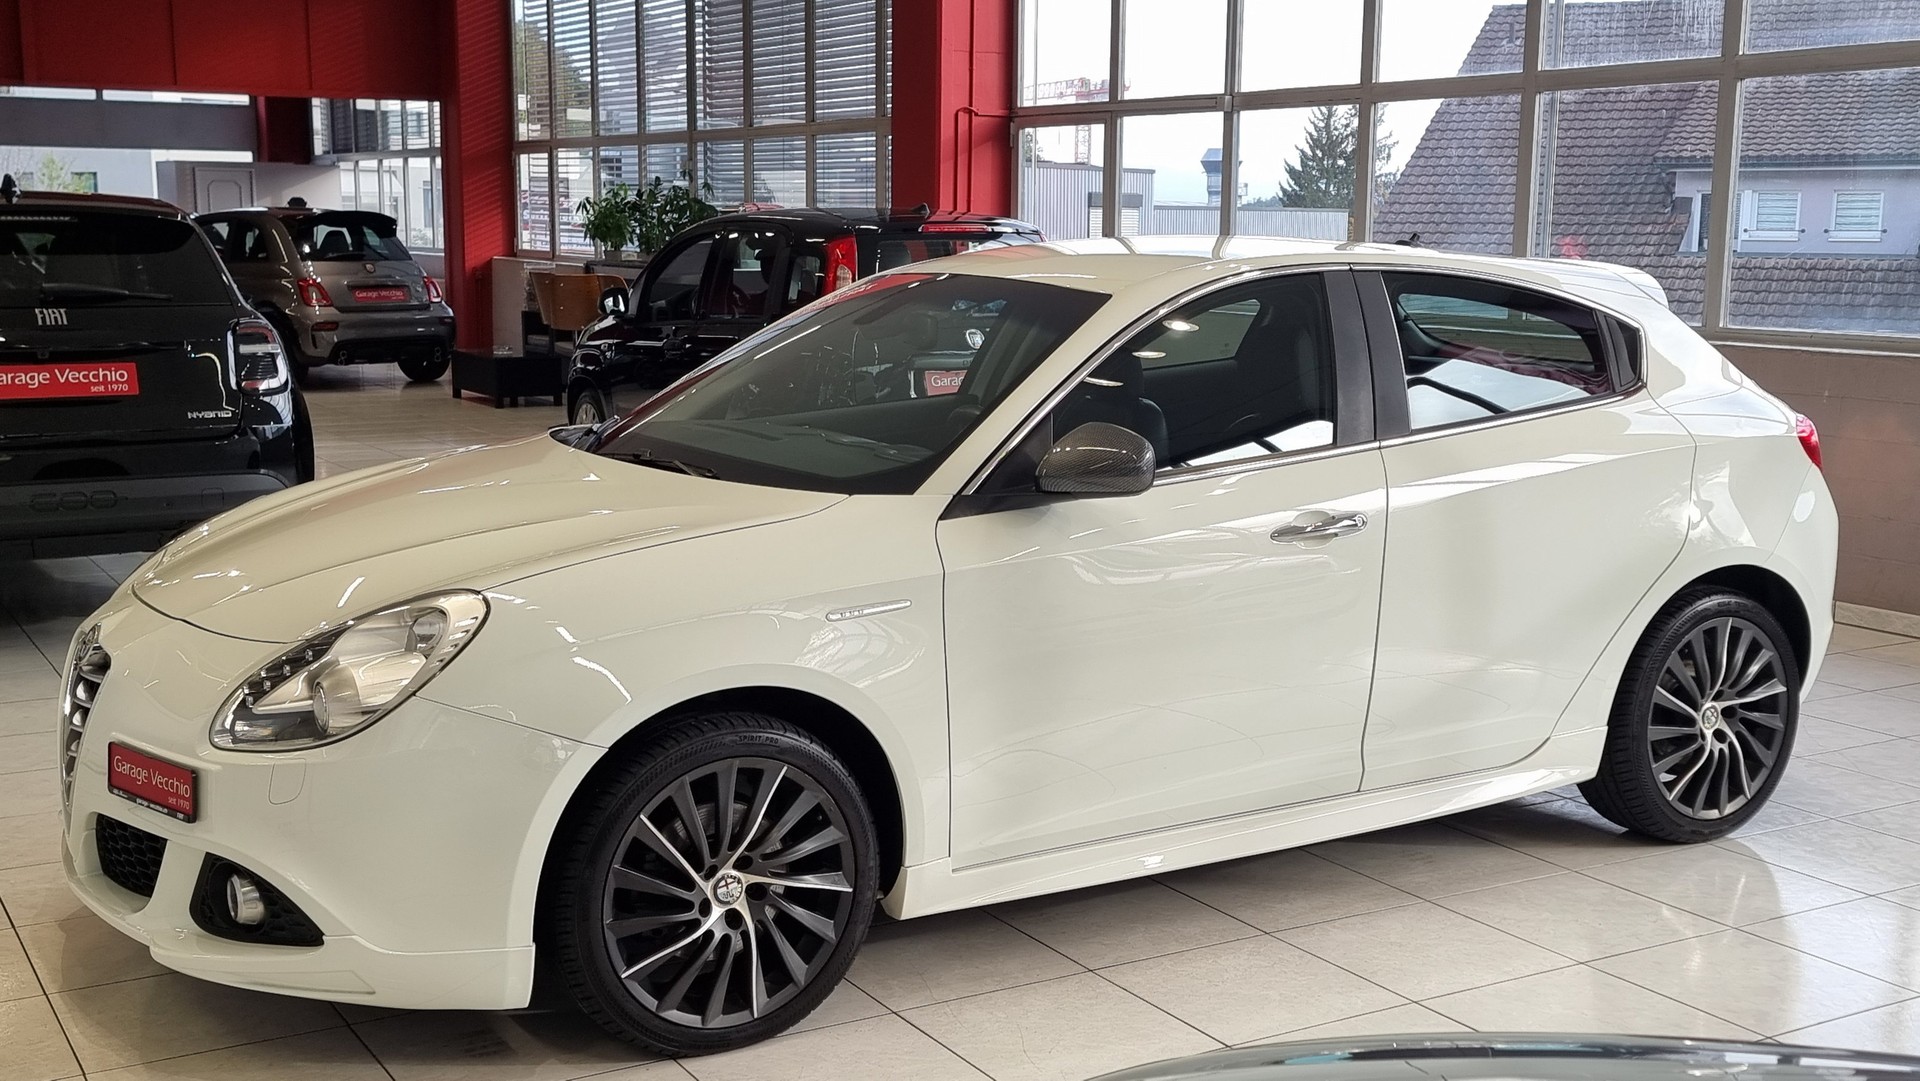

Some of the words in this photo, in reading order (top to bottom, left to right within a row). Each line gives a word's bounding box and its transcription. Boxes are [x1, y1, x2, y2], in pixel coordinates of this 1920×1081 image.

[34, 308, 68, 326] FIAT
[0, 371, 51, 389] arage
[54, 367, 129, 384] Vecchio
[90, 384, 106, 393] seit
[107, 383, 129, 392] 1970
[739, 734, 763, 743] SPIRIT
[764, 736, 779, 745] PRO
[113, 755, 149, 785] Garage
[150, 768, 191, 798] Vecchio
[168, 795, 177, 806] seit
[177, 797, 190, 811] 1970
